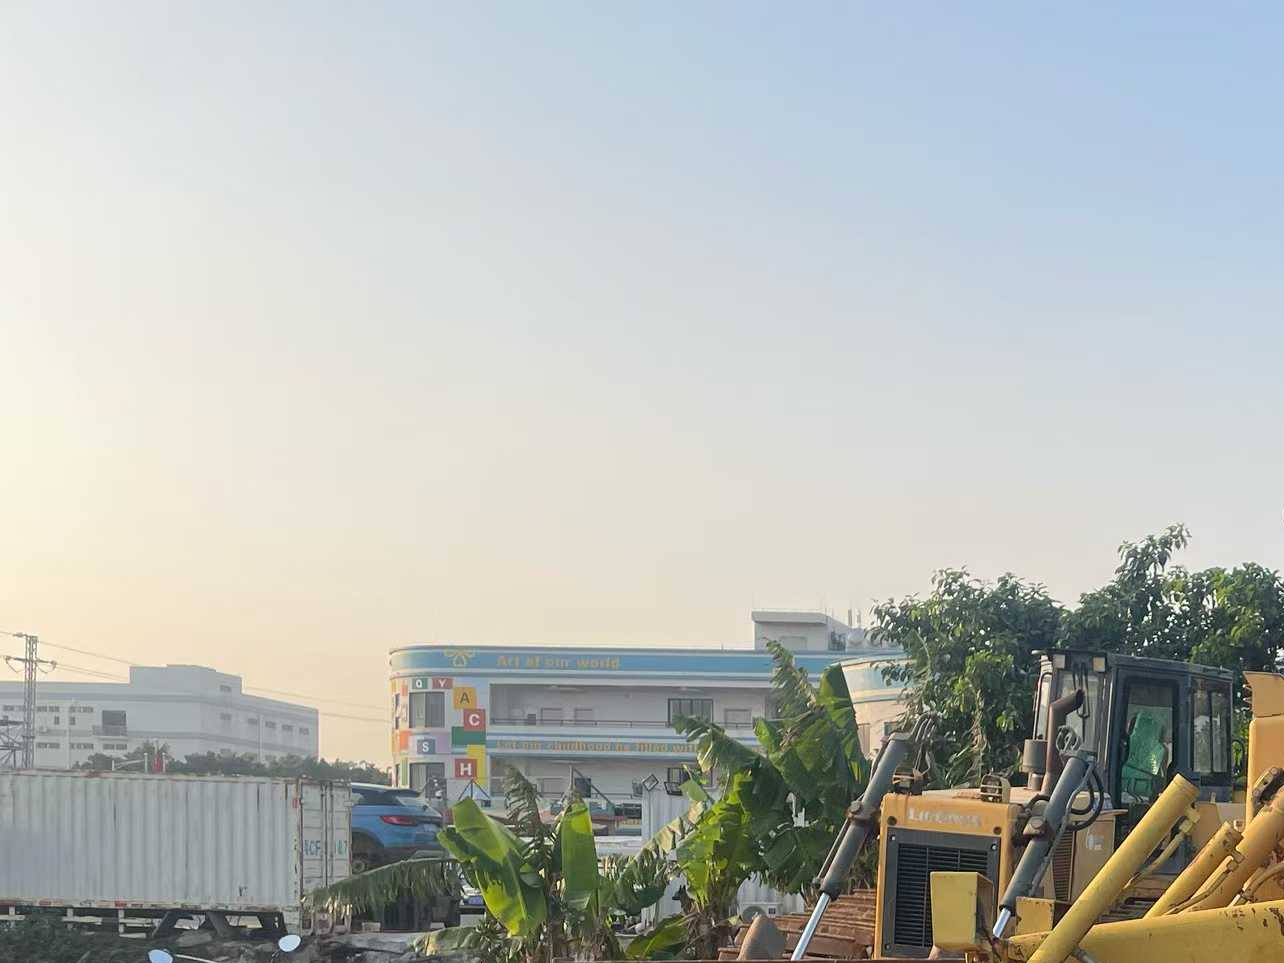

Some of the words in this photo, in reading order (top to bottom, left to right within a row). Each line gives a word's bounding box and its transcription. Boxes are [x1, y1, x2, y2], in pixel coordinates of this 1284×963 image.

[459, 692, 470, 704] A
[469, 713, 480, 727] C
[422, 742, 430, 752] S
[459, 763, 472, 776] H
